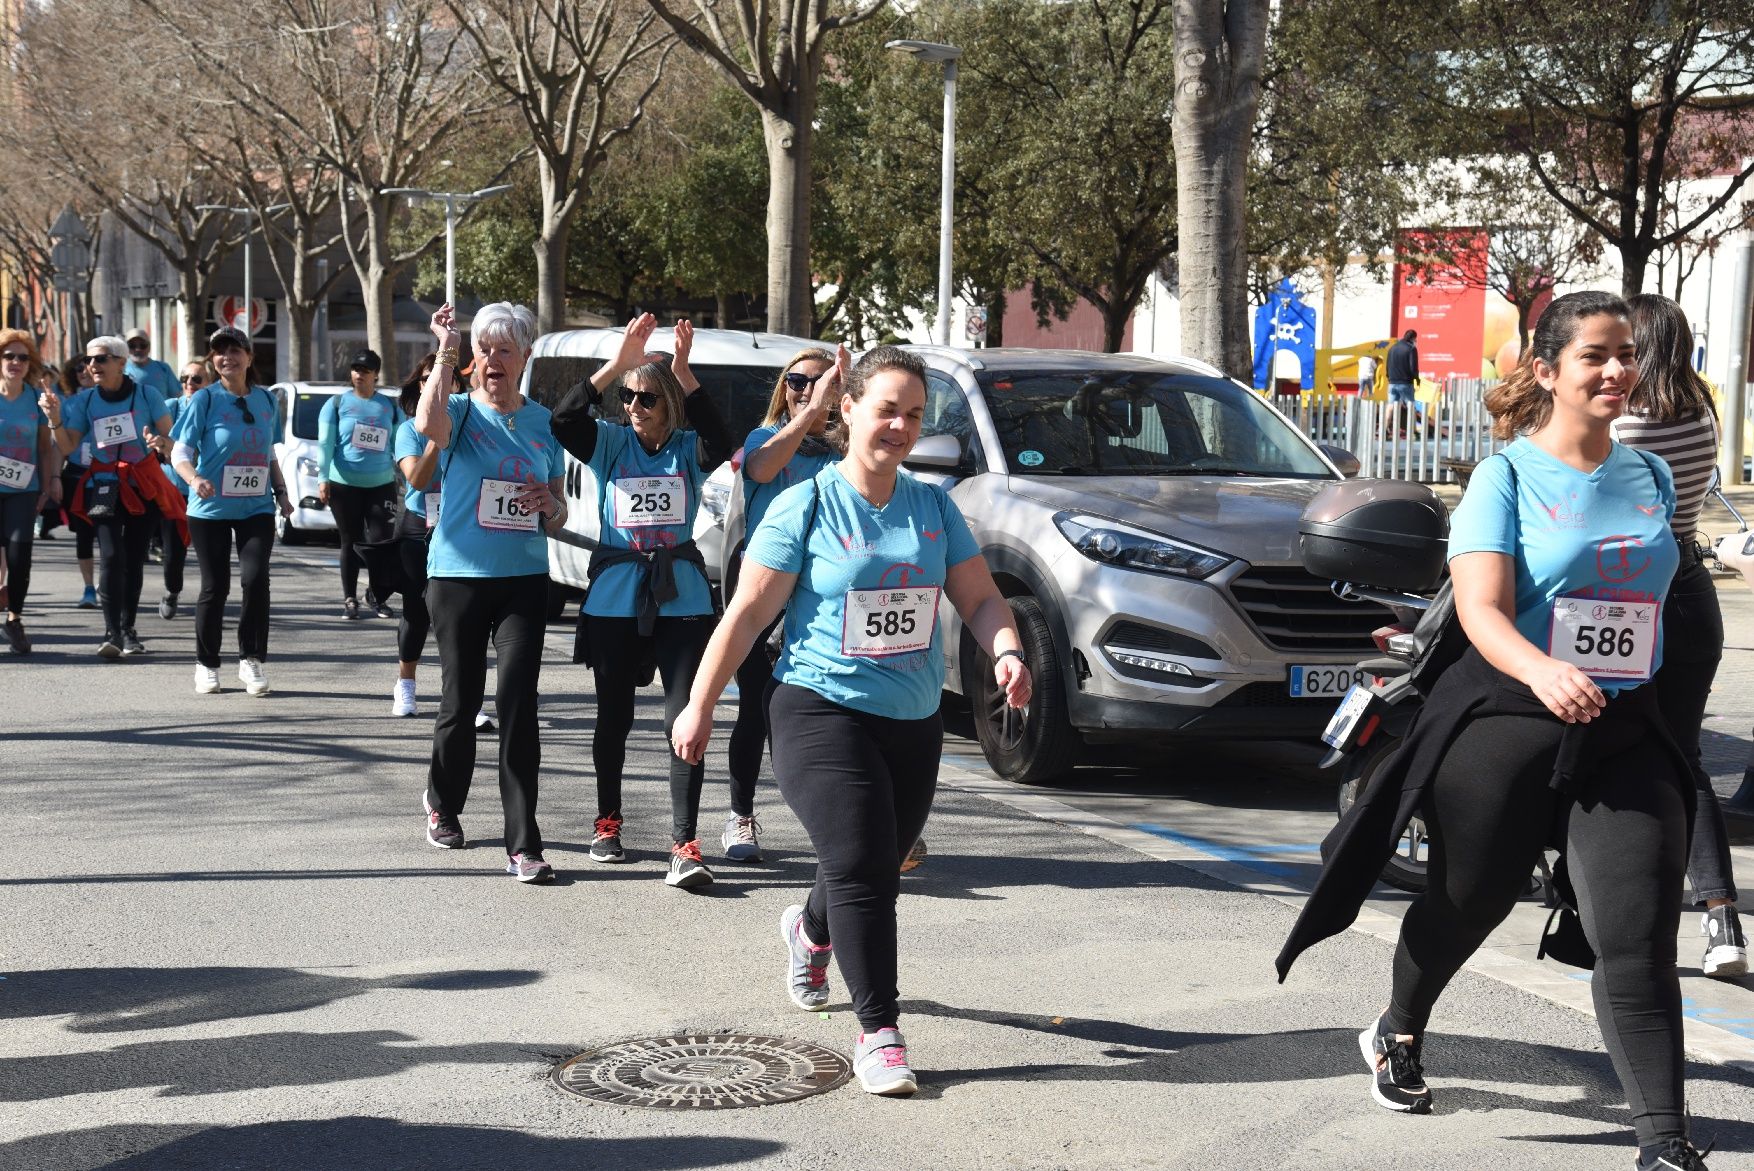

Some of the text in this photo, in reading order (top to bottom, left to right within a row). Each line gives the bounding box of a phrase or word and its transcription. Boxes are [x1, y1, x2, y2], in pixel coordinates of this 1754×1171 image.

[104, 424, 123, 437] 79
[360, 432, 379, 445] 584
[233, 475, 259, 488] 746
[631, 492, 671, 512] 253
[865, 609, 916, 637] 585
[1574, 625, 1634, 657] 586
[1306, 670, 1364, 693] 6208
